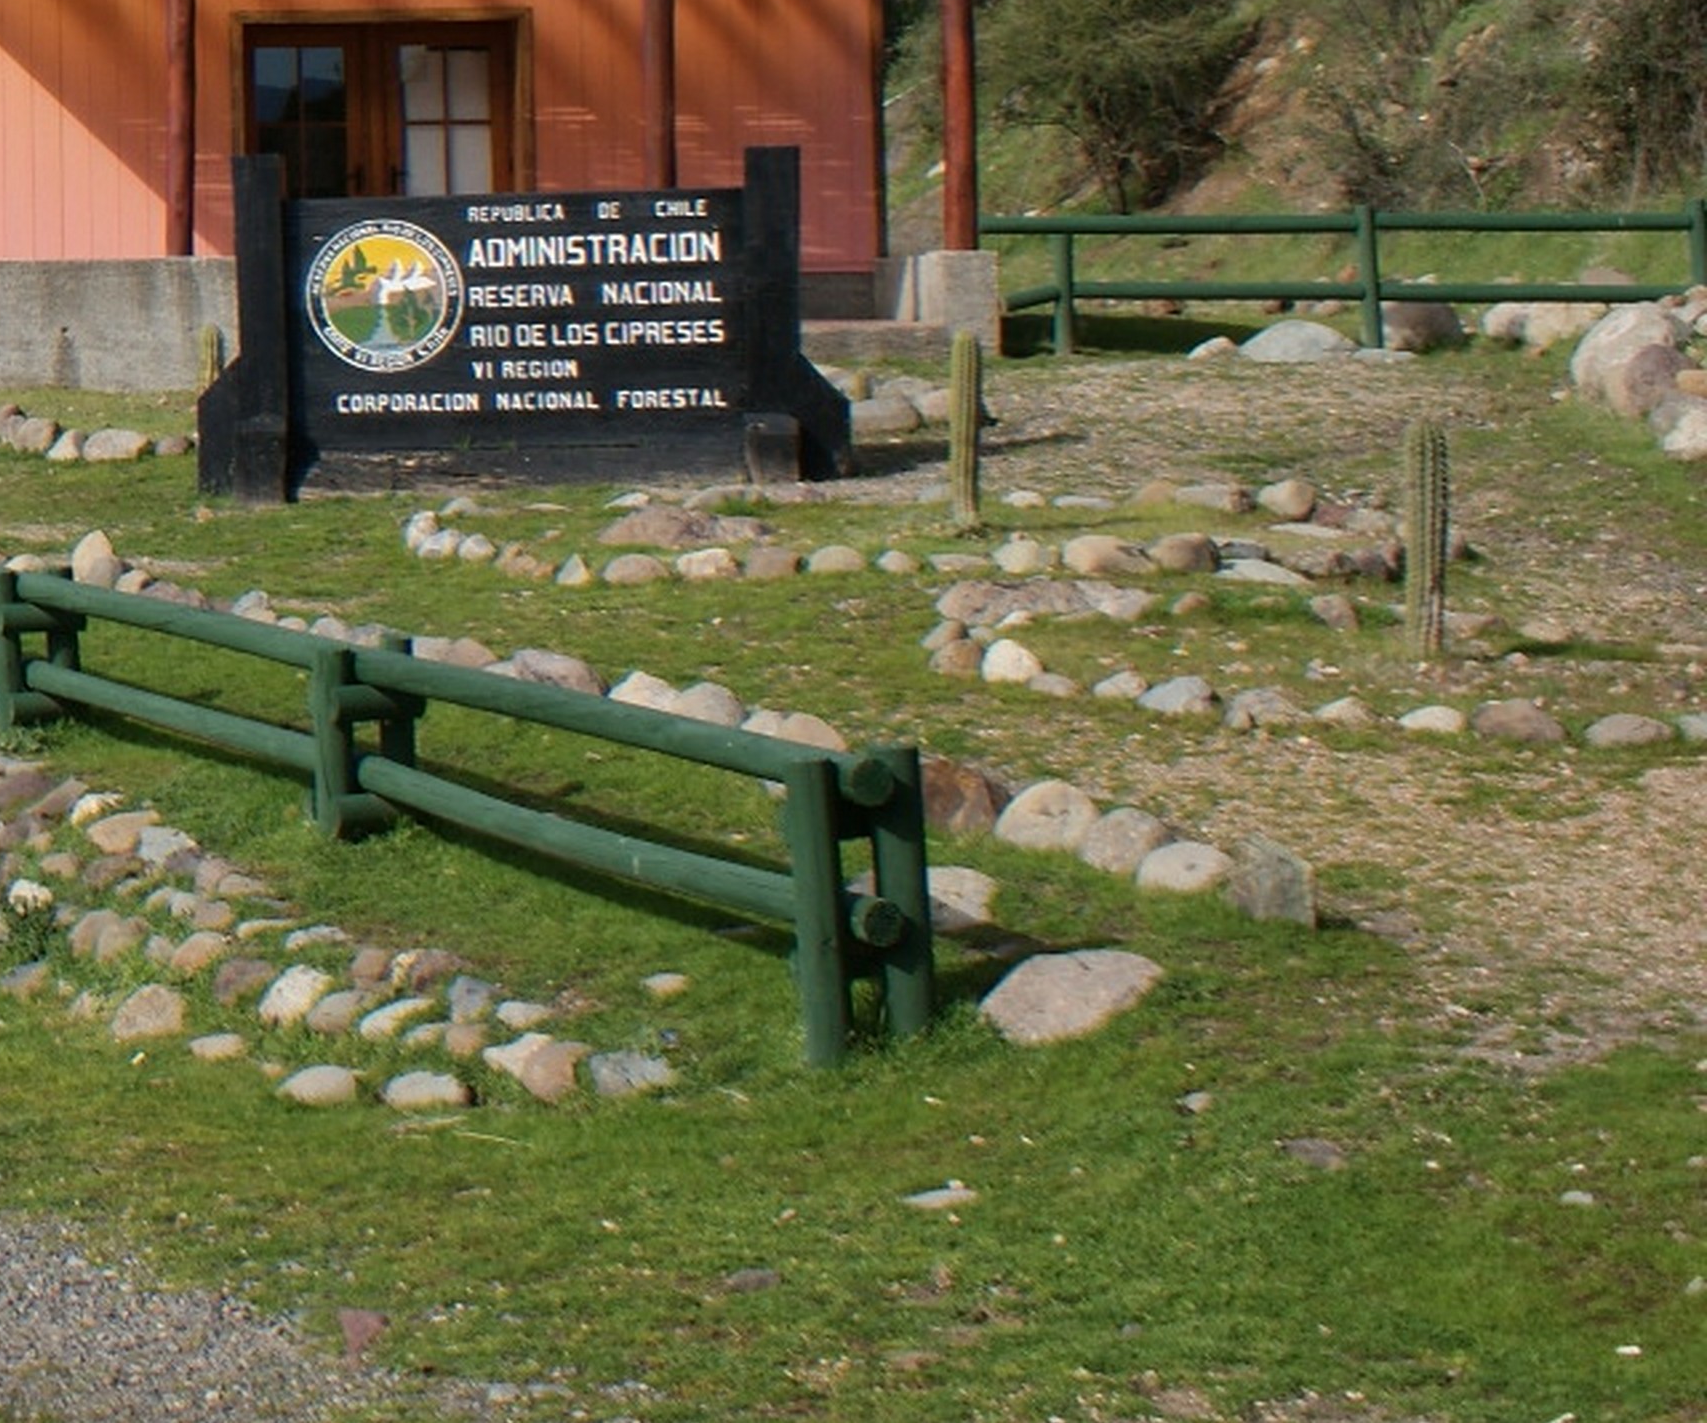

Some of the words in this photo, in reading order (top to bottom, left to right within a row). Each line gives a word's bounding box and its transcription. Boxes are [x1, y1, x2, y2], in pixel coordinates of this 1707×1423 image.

[467, 204, 565, 223] REPUBLICA
[598, 201, 621, 219] DE
[655, 199, 708, 217] CHILE
[468, 232, 721, 268] ADMINISTRACION
[469, 284, 575, 307] RESERVA
[602, 280, 723, 305] NACIONAL
[470, 325, 510, 348] RIO
[515, 324, 547, 346] DE
[552, 323, 598, 345] LOS
[605, 320, 725, 345] CIPRESES
[471, 361, 493, 380] VI
[501, 359, 579, 379] REGION
[336, 392, 481, 414] CORPORACION
[496, 391, 599, 411] NACIONAL
[616, 388, 729, 409] FORESTAL
